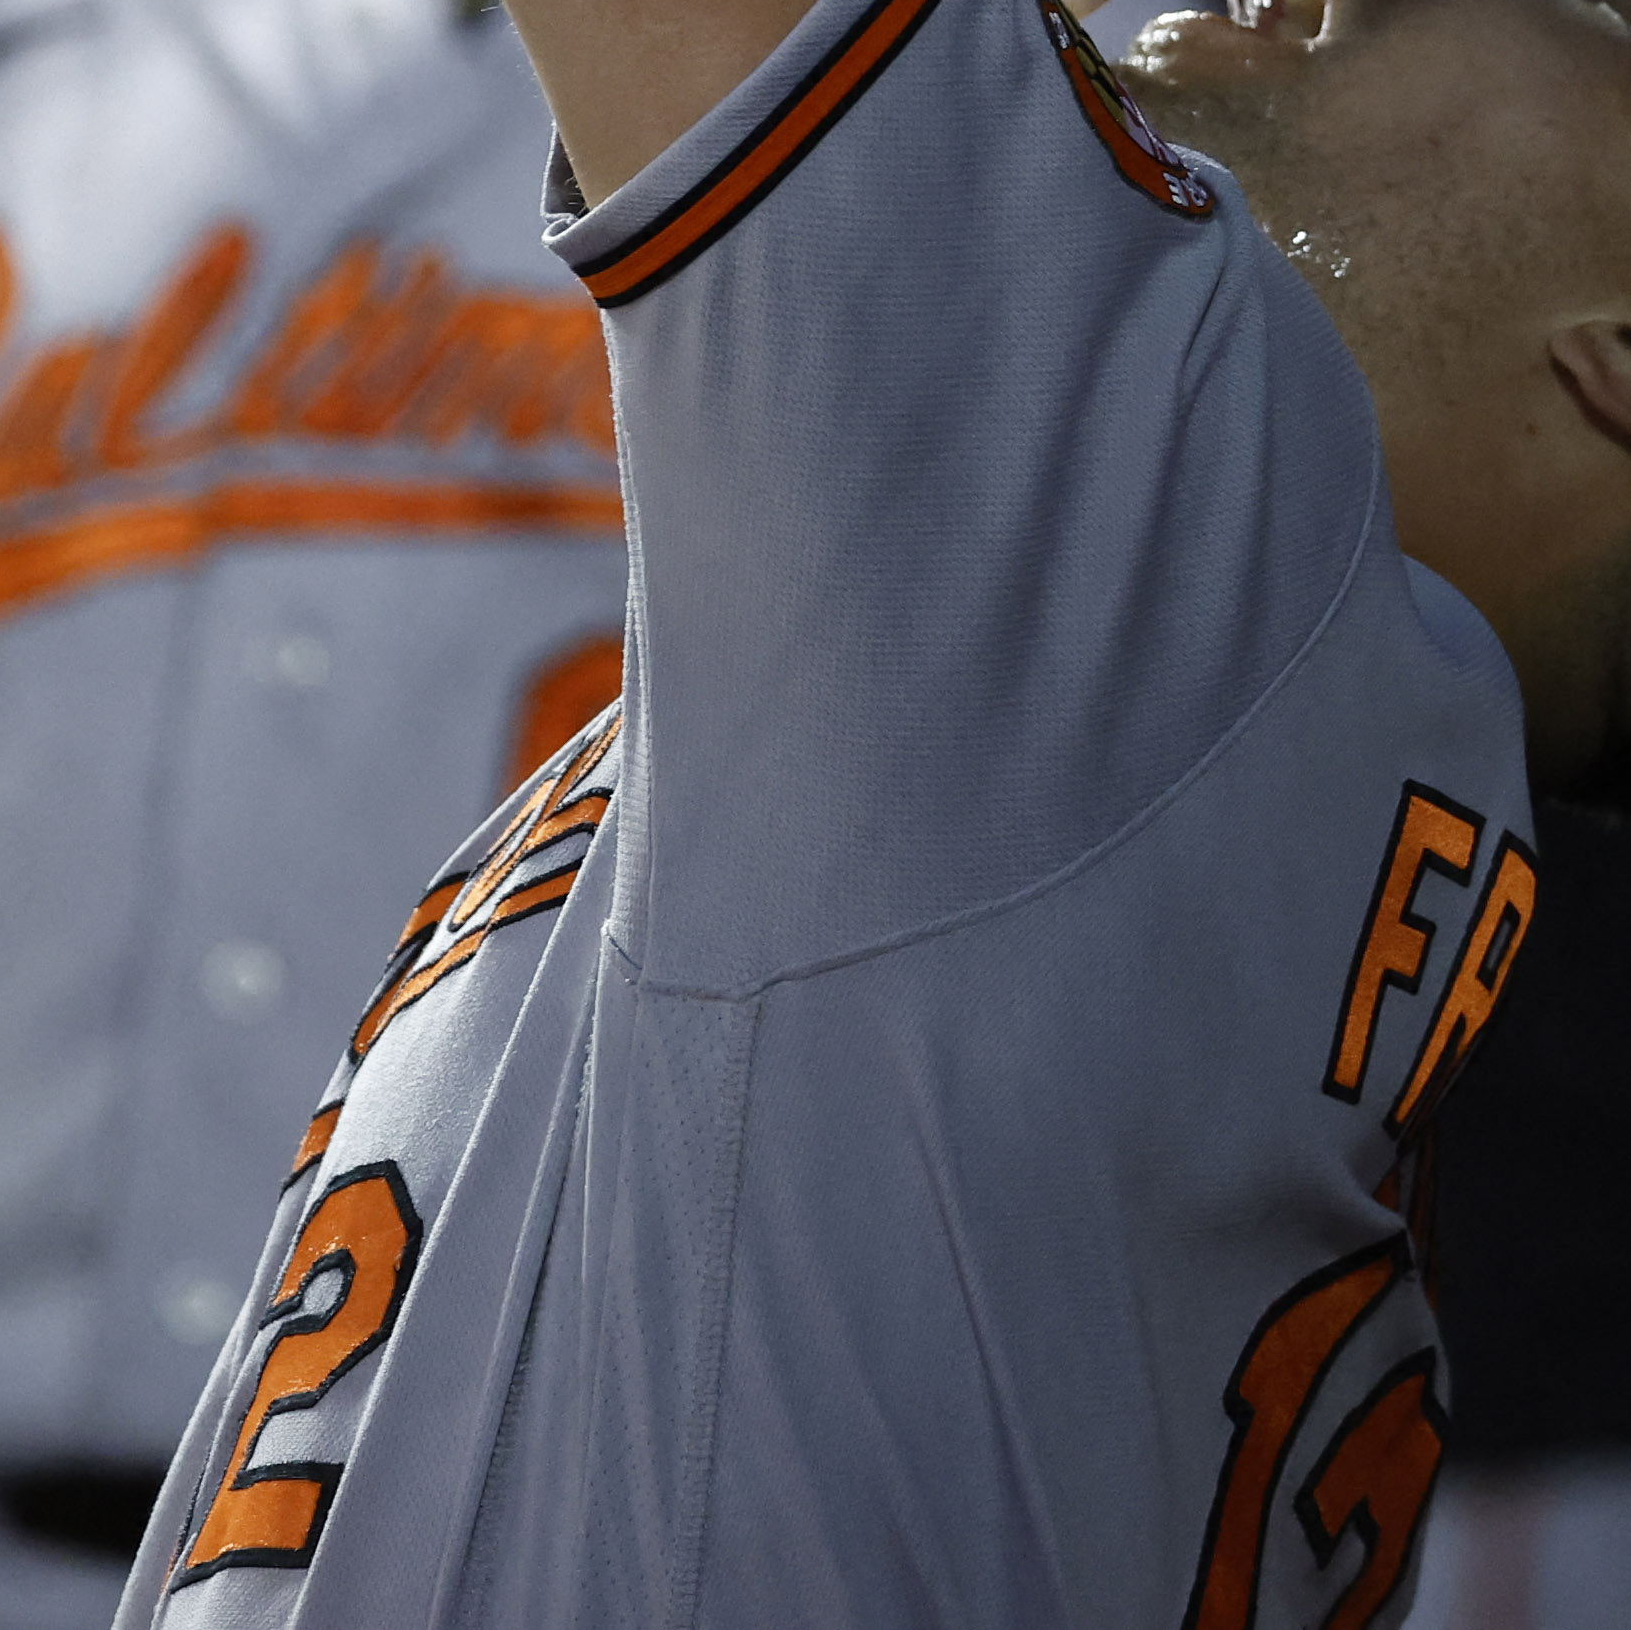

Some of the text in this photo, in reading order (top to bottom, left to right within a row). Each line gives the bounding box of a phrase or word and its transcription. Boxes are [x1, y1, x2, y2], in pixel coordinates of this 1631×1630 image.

[1320, 778, 1538, 1160] FR
[166, 1156, 424, 1596] 2
[1178, 1226, 1454, 1630] 12
